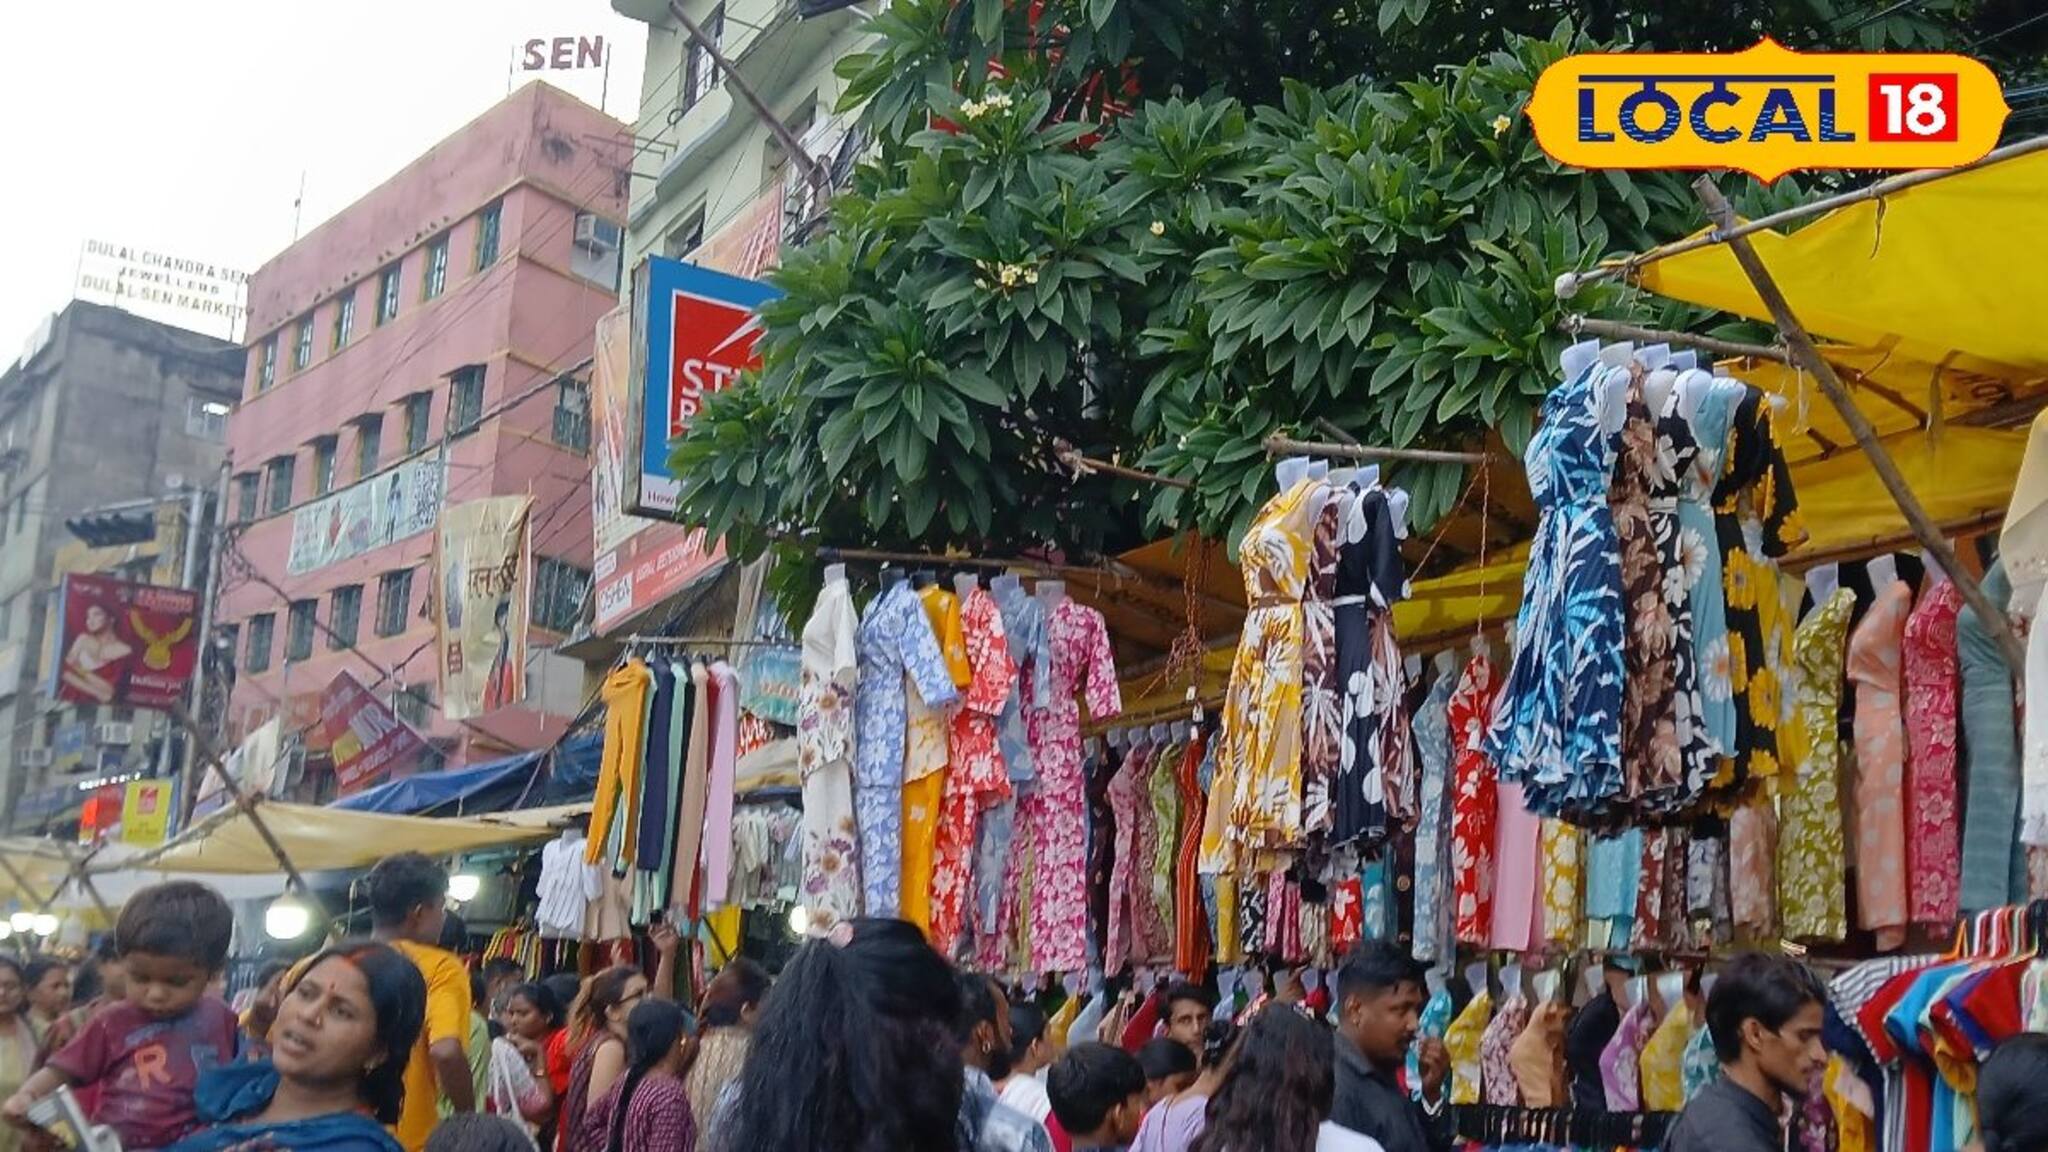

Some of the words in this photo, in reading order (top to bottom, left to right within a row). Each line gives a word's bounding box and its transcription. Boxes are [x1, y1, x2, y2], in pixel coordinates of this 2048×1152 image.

[522, 35, 603, 70] SEN
[87, 240, 136, 262] DULAL
[142, 251, 215, 278] CHANDRA
[220, 268, 250, 285] SEN
[118, 267, 220, 295] JEWELLERS
[81, 274, 136, 298] DULAL
[141, 287, 173, 305] SEN
[176, 294, 244, 319] MARKET
[134, 1044, 172, 1092] R
